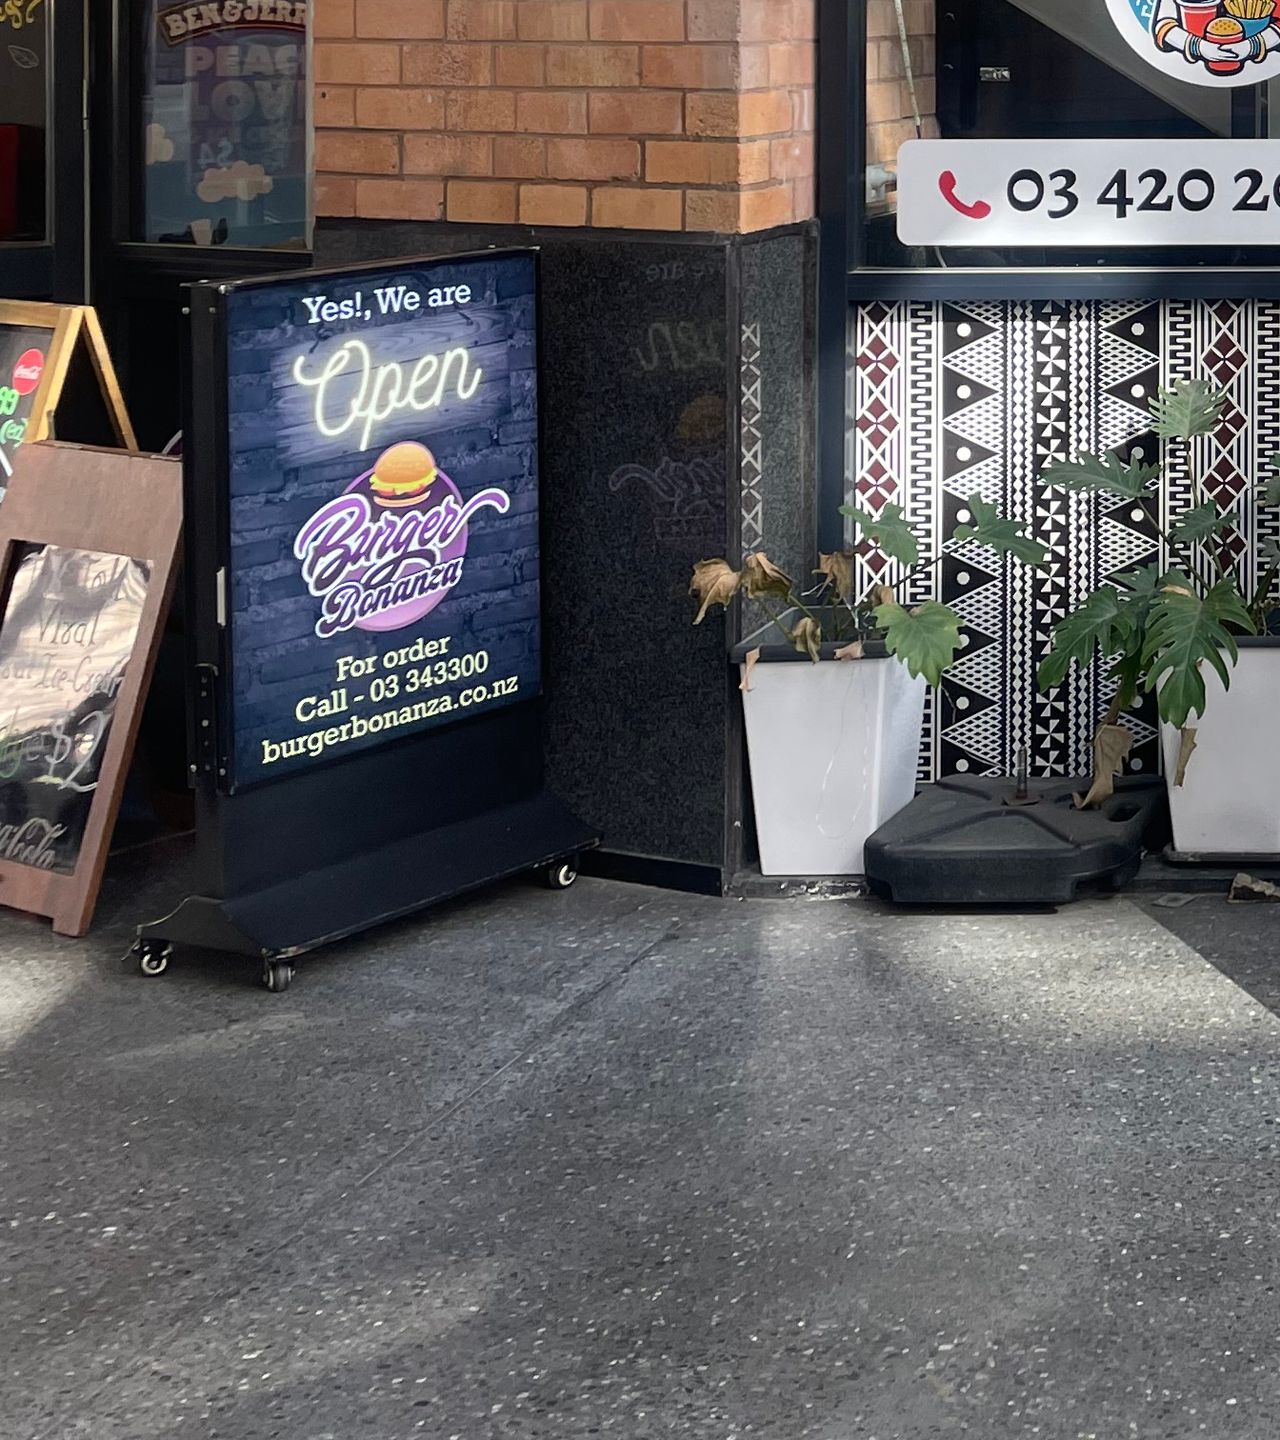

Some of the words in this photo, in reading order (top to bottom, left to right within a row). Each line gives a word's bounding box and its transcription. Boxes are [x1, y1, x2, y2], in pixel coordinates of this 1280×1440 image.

[185, 44, 306, 77] PEAC
[191, 80, 306, 121] LOV
[1006, 168, 1079, 217] 03
[1097, 168, 1213, 217] 420
[303, 292, 371, 323] Yes!,
[375, 285, 421, 313] We
[424, 282, 472, 308] are
[294, 338, 482, 451] Open
[294, 487, 510, 592] Burger
[315, 556, 464, 638] Bonanza
[295, 689, 348, 723] Call
[369, 674, 400, 703] 03
[405, 650, 489, 695] 343300
[336, 652, 380, 681] For
[383, 633, 451, 671] order
[261, 673, 518, 765] burgerbonanza.co.nz
